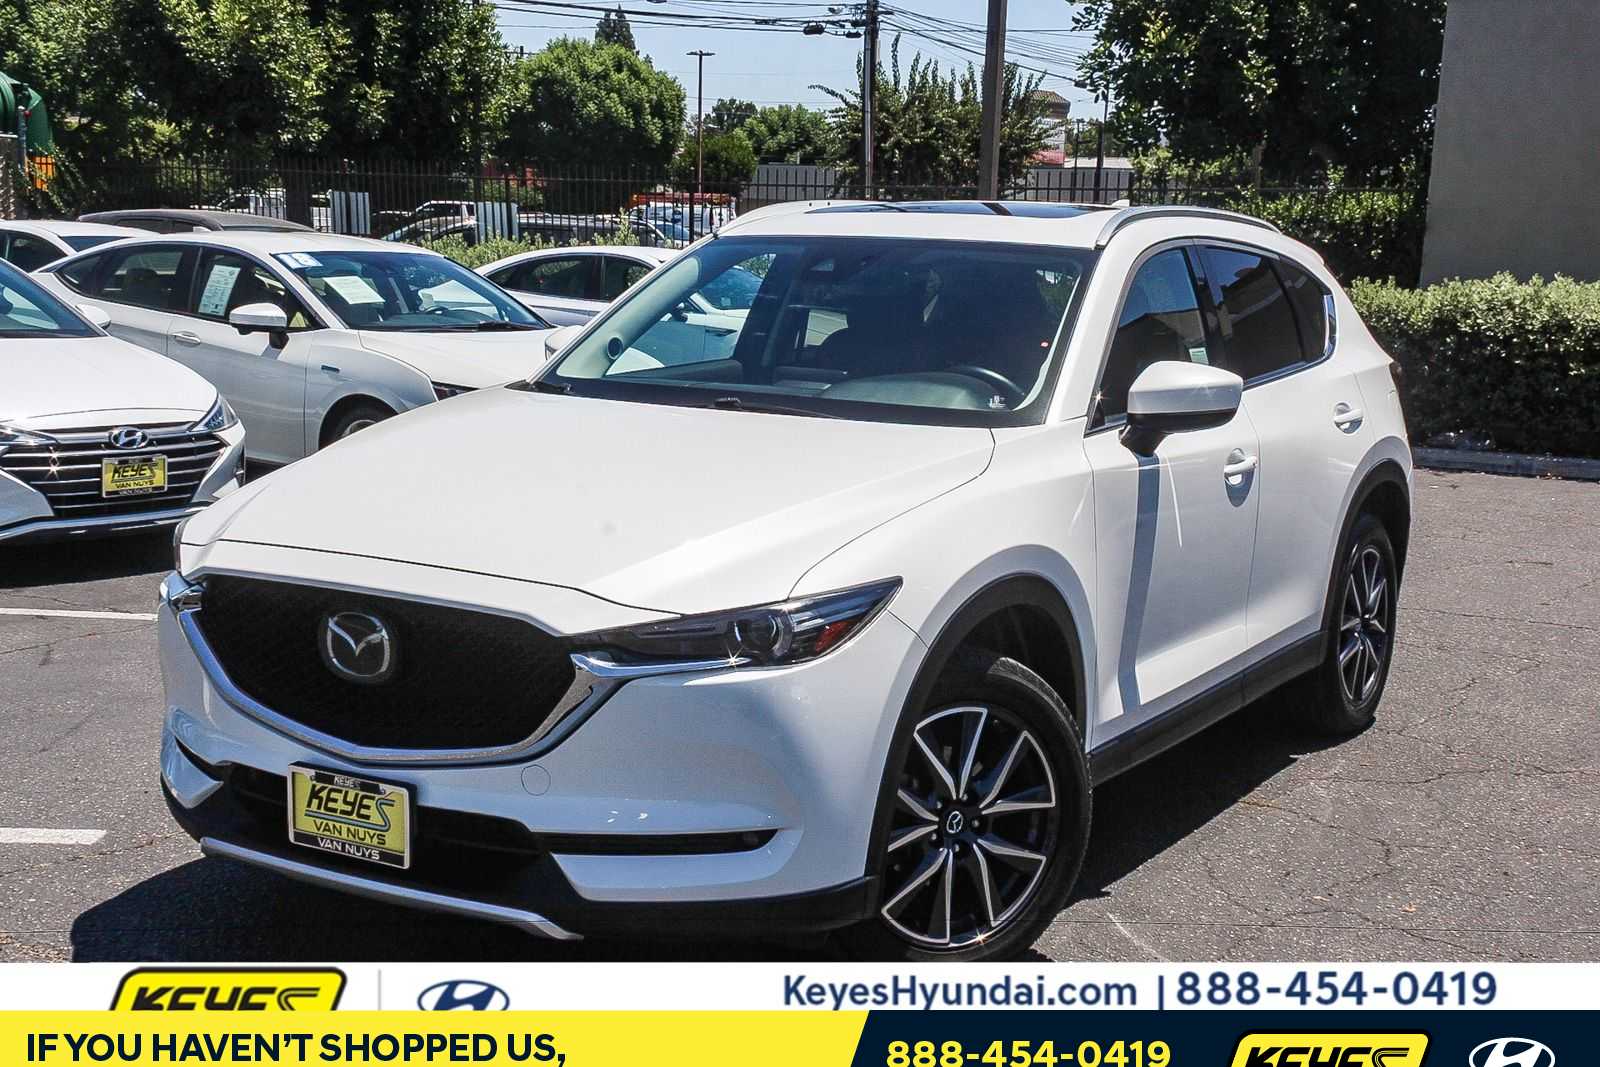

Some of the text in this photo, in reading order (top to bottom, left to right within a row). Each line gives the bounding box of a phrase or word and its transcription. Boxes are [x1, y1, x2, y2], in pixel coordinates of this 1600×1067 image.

[111, 463, 159, 483] KEYES
[115, 481, 131, 489] VAN
[333, 775, 361, 789] KEYES
[304, 783, 396, 833] KEYES
[313, 819, 387, 846] VAN NUYS
[317, 837, 381, 861] VAN NUYS
